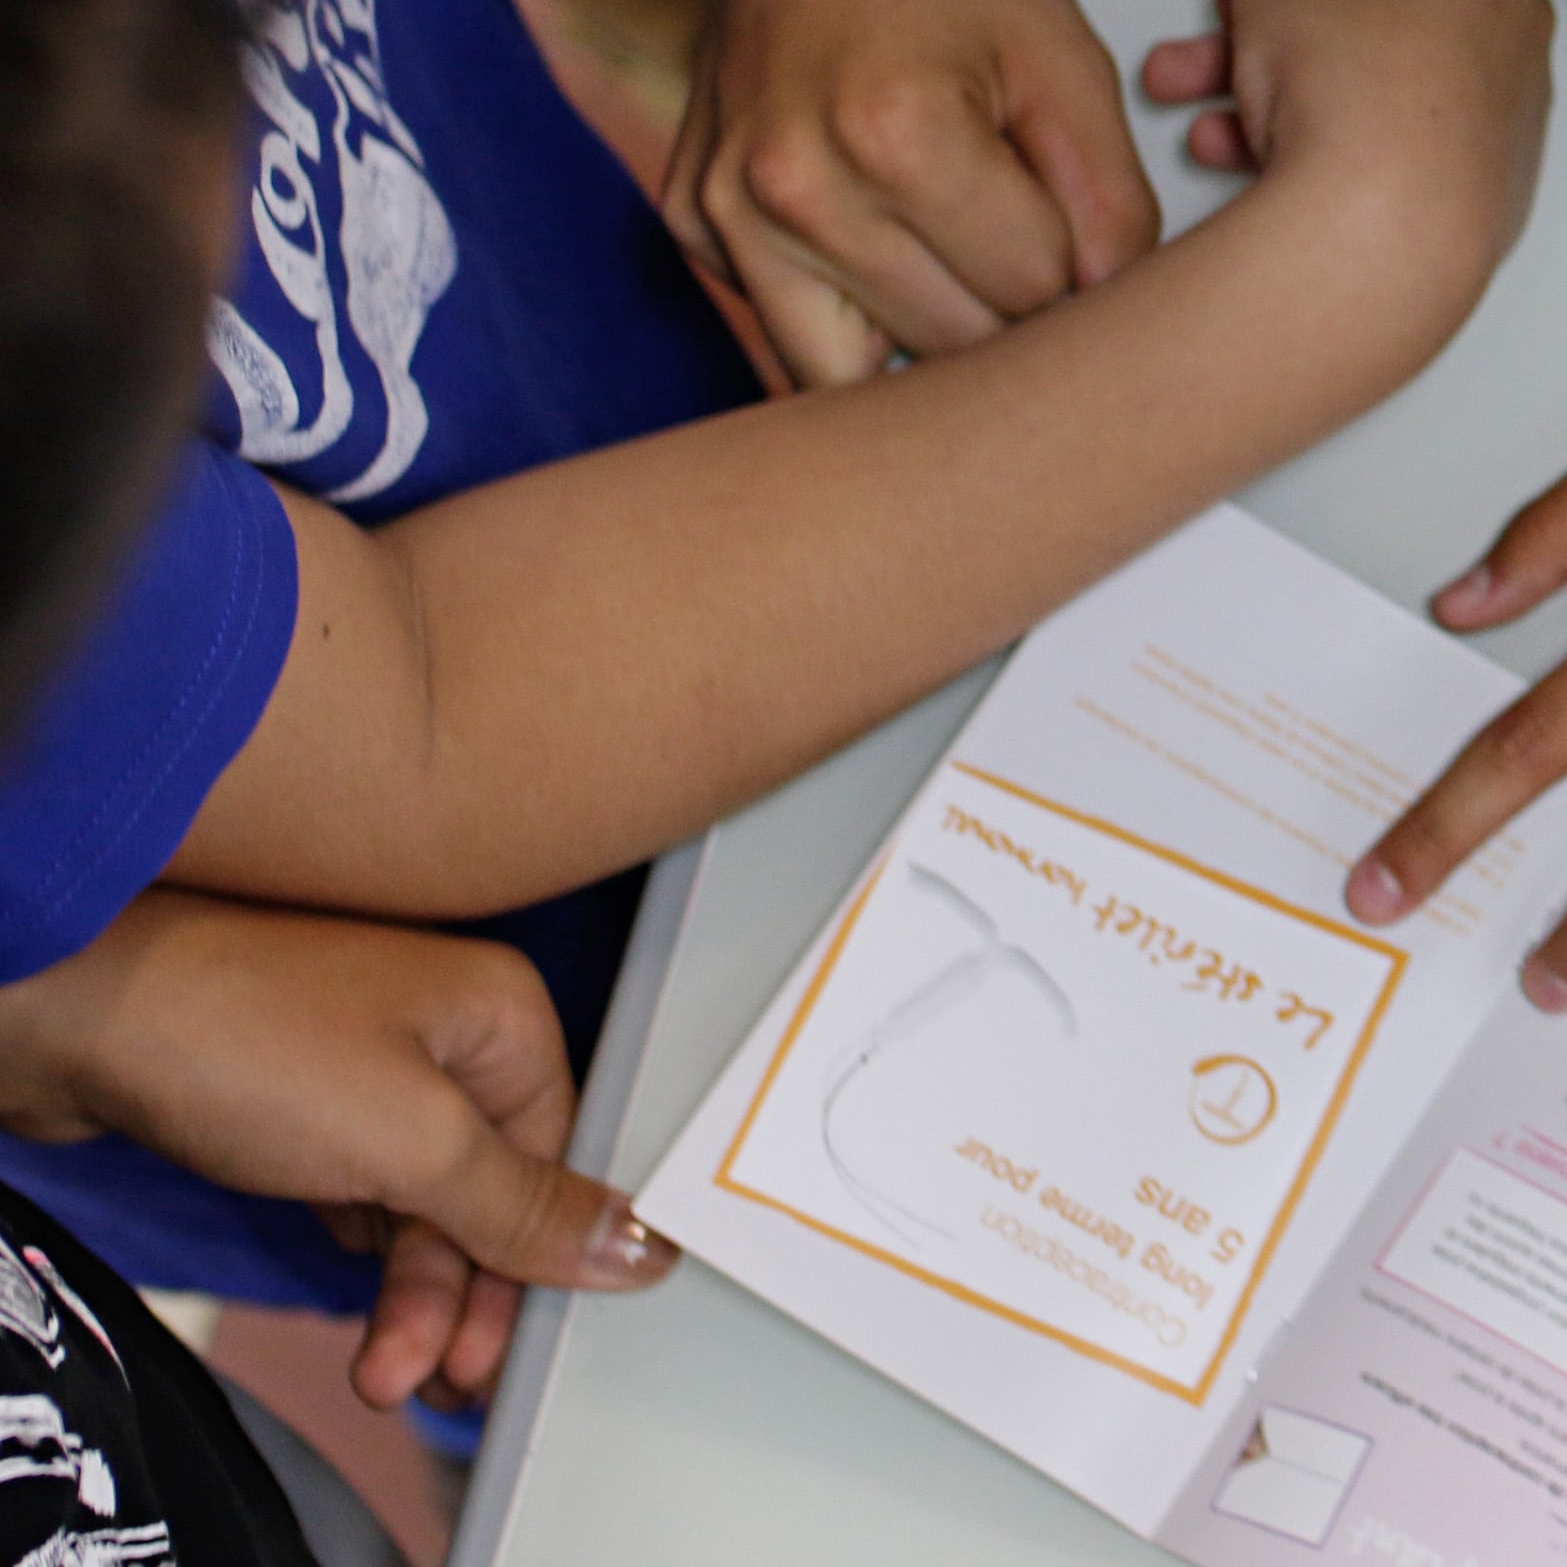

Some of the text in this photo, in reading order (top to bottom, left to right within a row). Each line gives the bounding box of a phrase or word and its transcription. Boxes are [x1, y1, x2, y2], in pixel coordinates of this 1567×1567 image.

[1077, 889, 1265, 1019] stérilet
[1261, 986, 1338, 1054] Le
[947, 1128, 1220, 1310] long terme pour
[971, 1202, 1194, 1354] Contraception
[1126, 1173, 1249, 1268] 5 ans
